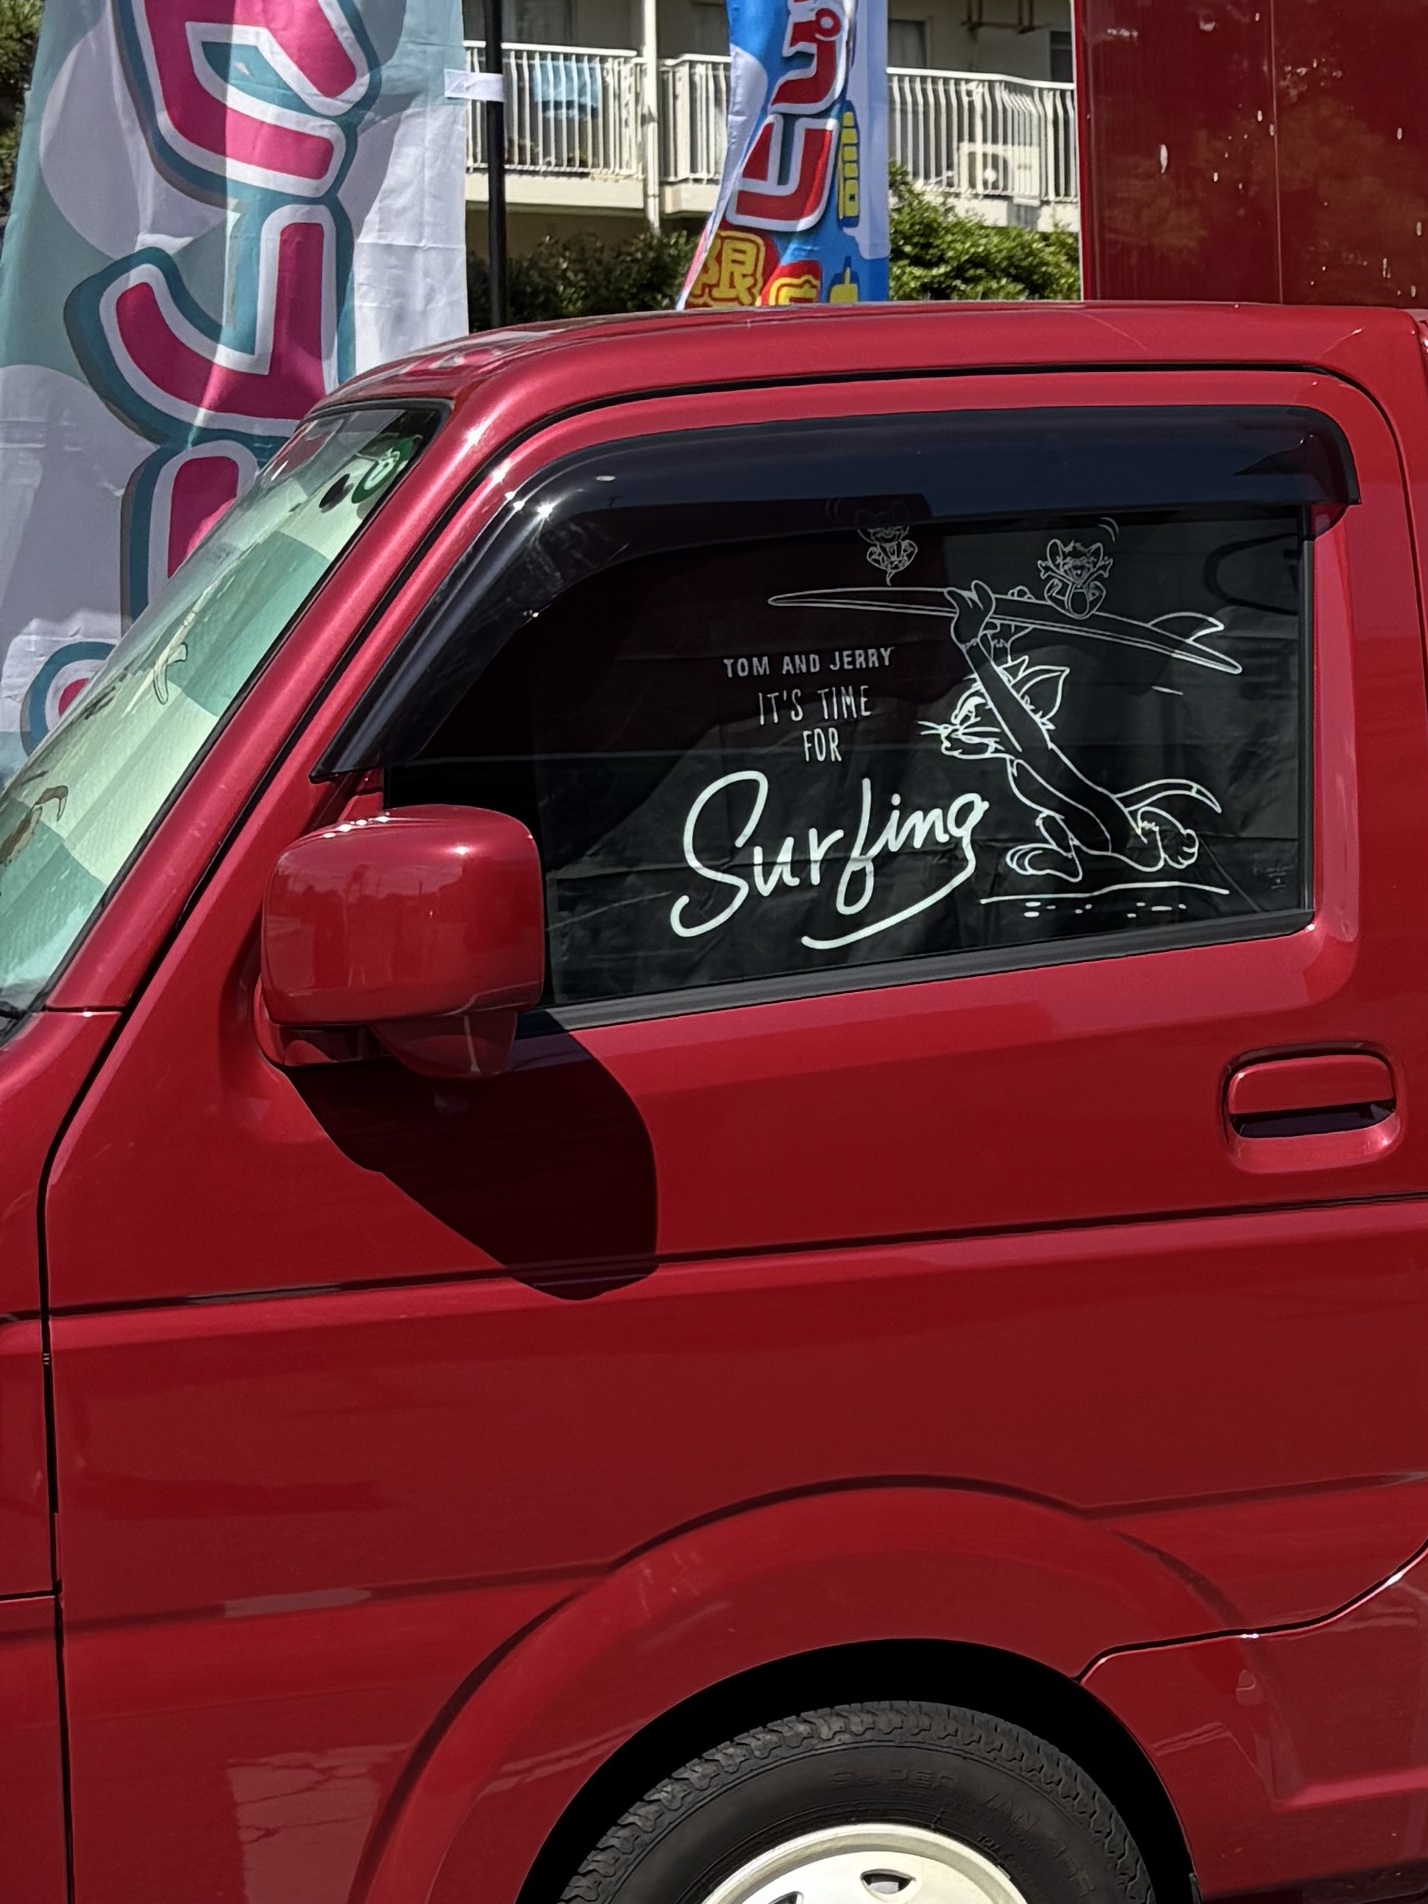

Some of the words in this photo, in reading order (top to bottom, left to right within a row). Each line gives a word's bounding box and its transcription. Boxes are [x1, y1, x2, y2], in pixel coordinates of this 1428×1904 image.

[723, 657, 769, 679] TOM
[781, 654, 820, 676] AND
[829, 646, 896, 671] JERRY
[758, 691, 804, 726] IT'S
[815, 685, 873, 721] TIME
[803, 727, 843, 764] FOR
[670, 769, 990, 951] Surfing
